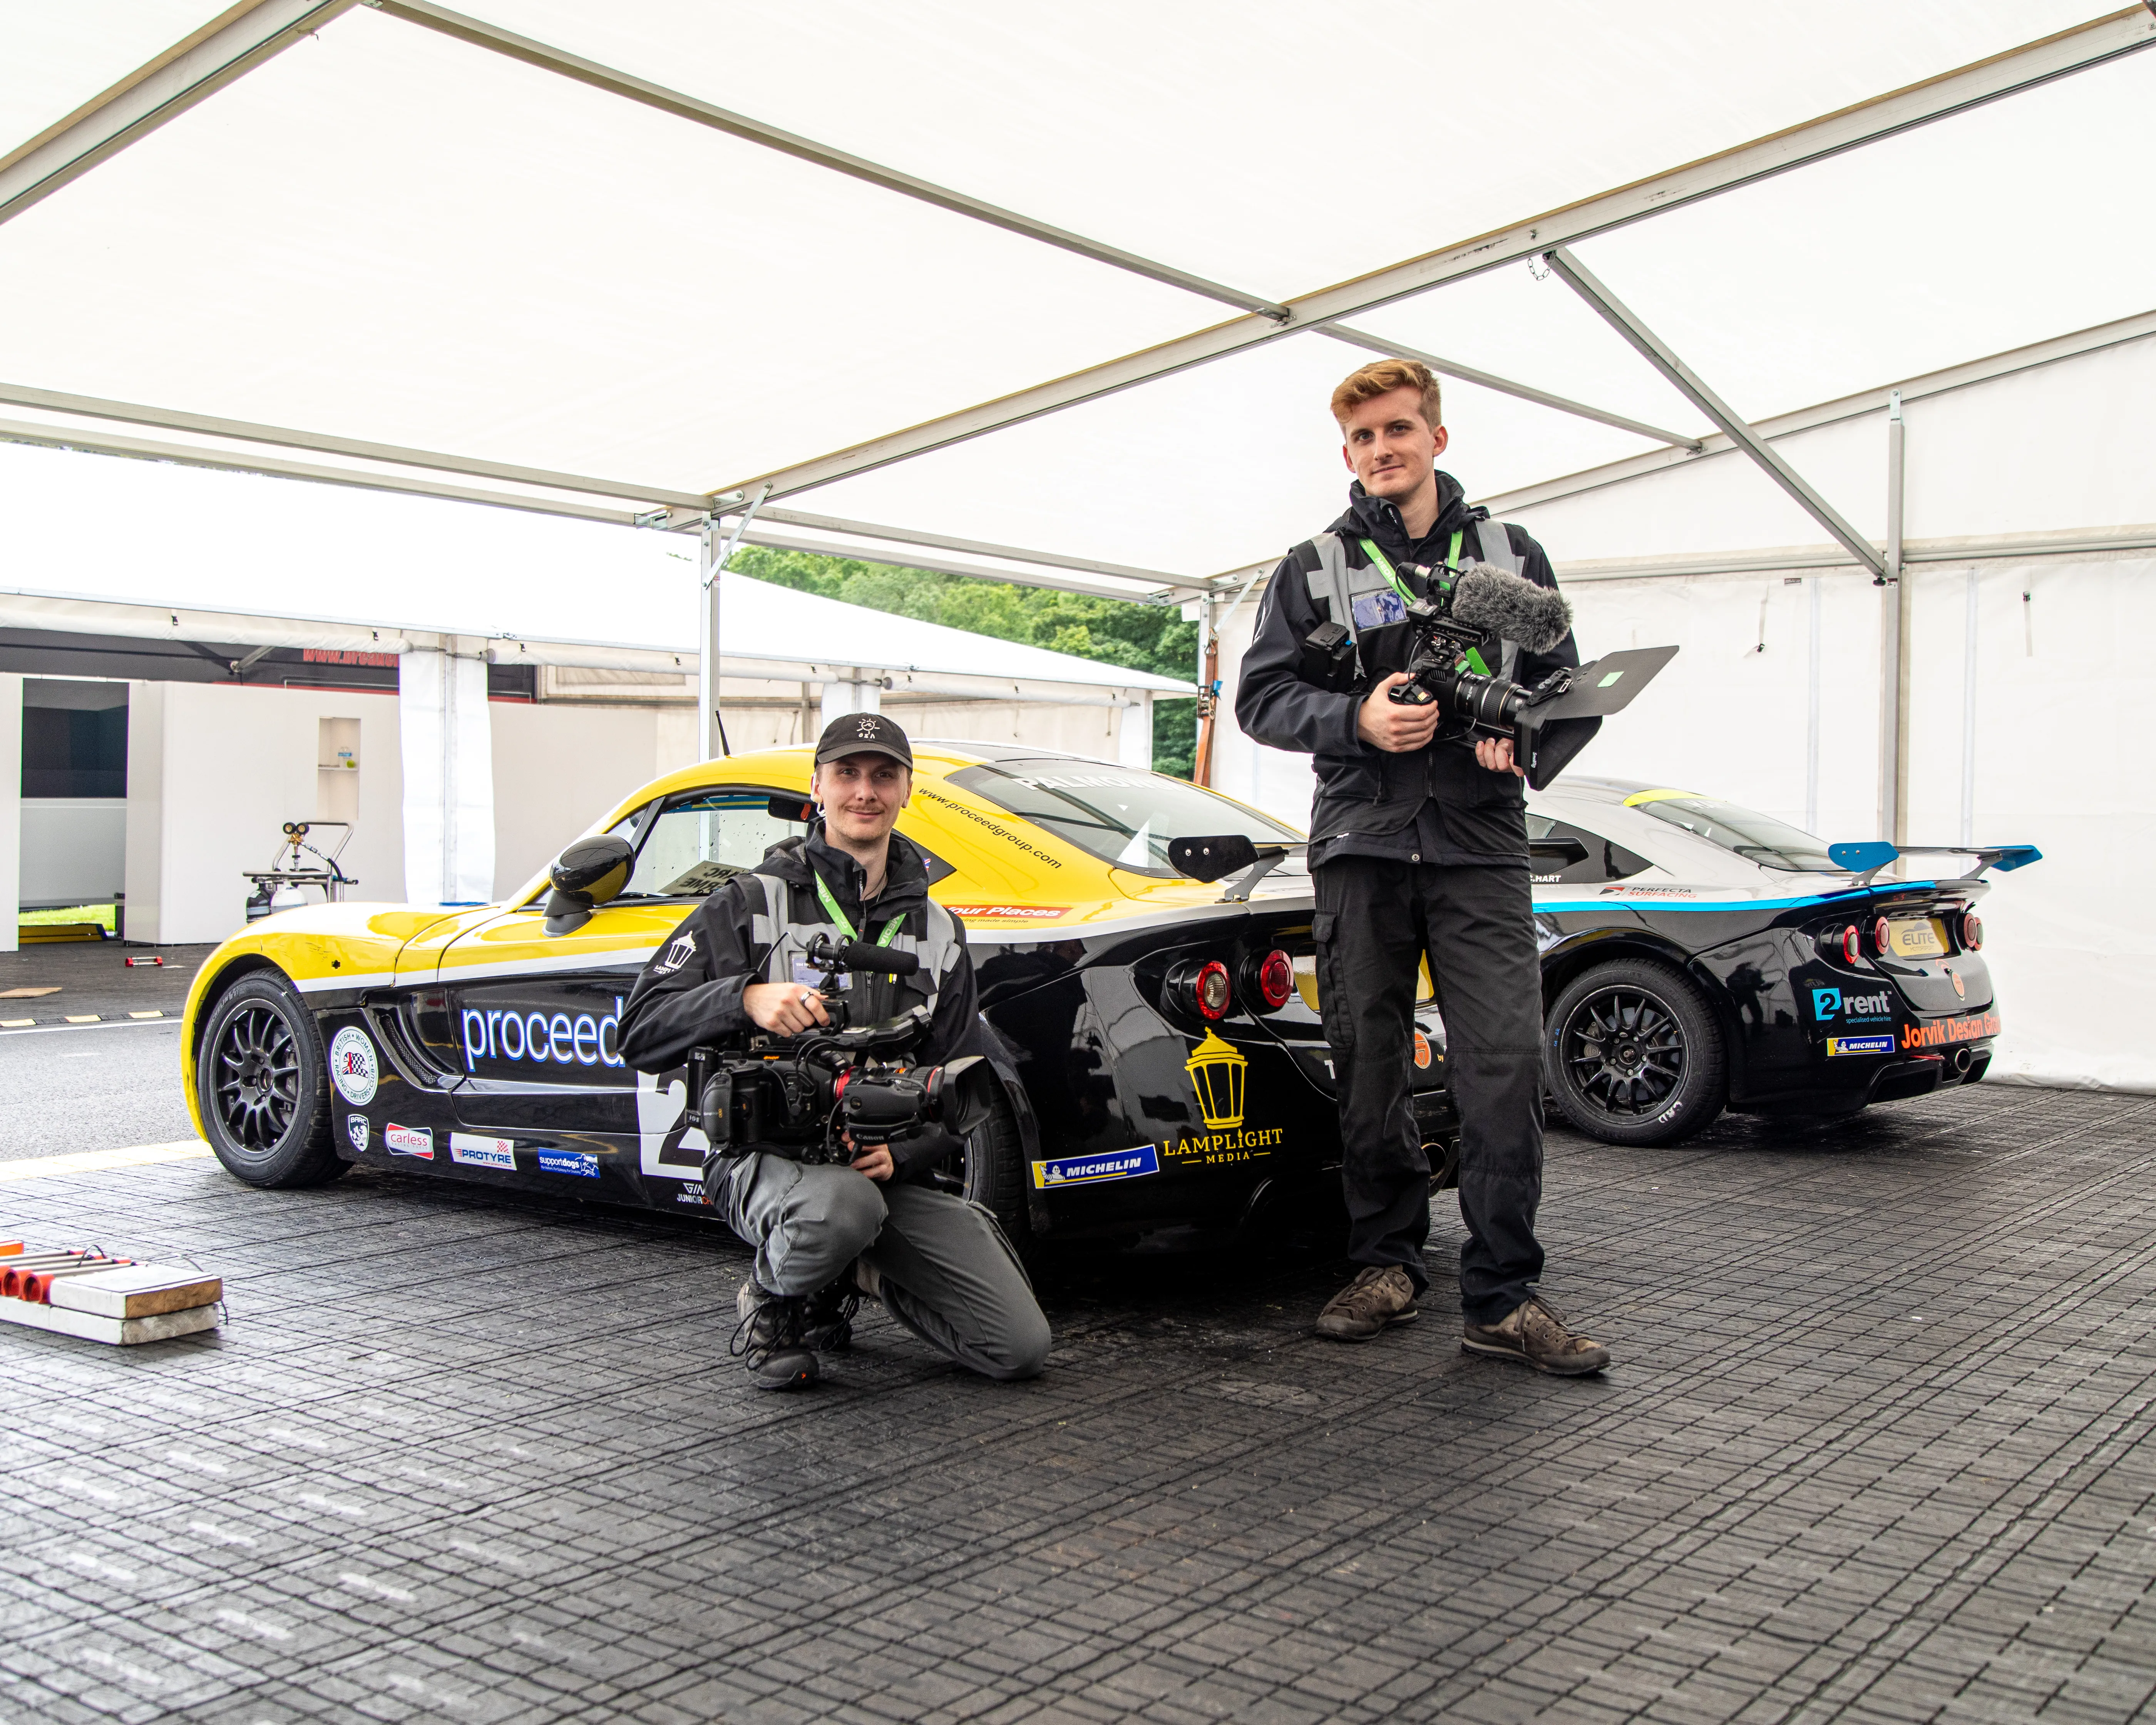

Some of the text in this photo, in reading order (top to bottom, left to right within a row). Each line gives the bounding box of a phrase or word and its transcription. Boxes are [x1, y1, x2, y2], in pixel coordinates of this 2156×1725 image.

[1375, 557, 1396, 584] MEDIA
[918, 788, 1062, 869] www.proceedgroup.com
[986, 907, 1061, 916] Places
[879, 916, 900, 945] MEDIA
[1902, 933, 1935, 946] ELITE
[462, 996, 625, 1072] proceed
[1901, 1019, 1946, 1049] Jorvik
[1947, 1015, 1984, 1042] Design
[335, 1033, 373, 1062] BRITISH WOMEN
[1849, 1041, 1888, 1050] MICHELIN
[335, 1064, 348, 1092] RACING
[350, 1089, 370, 1100] DRIVERS
[350, 1117, 367, 1125] BARC
[391, 1133, 427, 1146] carless
[462, 1149, 511, 1164] PROTYRE
[539, 1157, 580, 1169] supportdogs
[1206, 1152, 1250, 1164] MEDIA
[1066, 1157, 1142, 1177] MICHELIN
